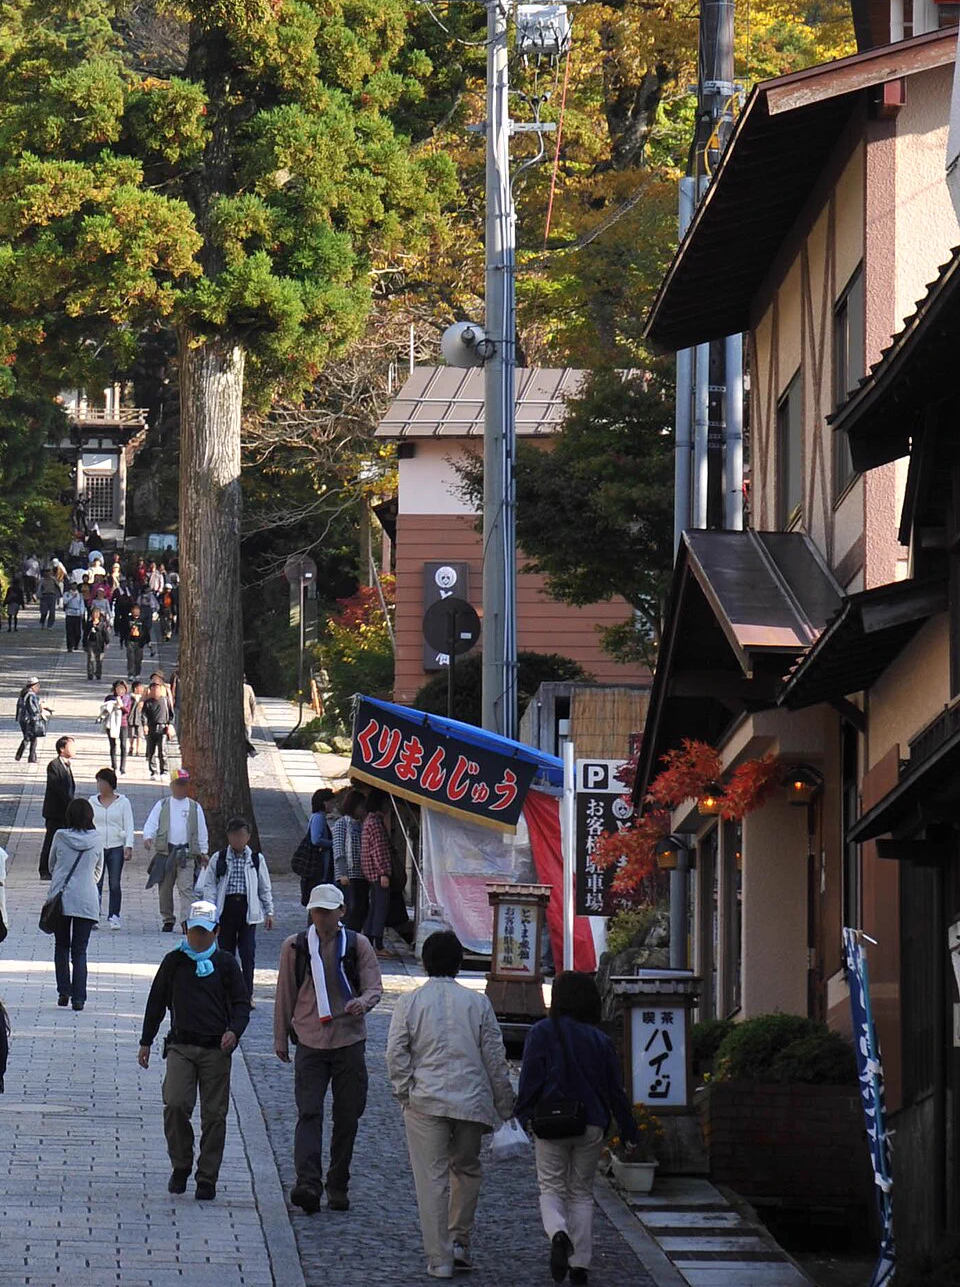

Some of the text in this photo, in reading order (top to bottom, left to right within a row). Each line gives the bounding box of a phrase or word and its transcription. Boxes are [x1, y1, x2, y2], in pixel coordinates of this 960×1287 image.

[357, 718, 518, 811] くりまんじゅう
[587, 765, 605, 788] P
[642, 1011, 674, 1025] 喫茶
[644, 1028, 673, 1099] ハイジ
